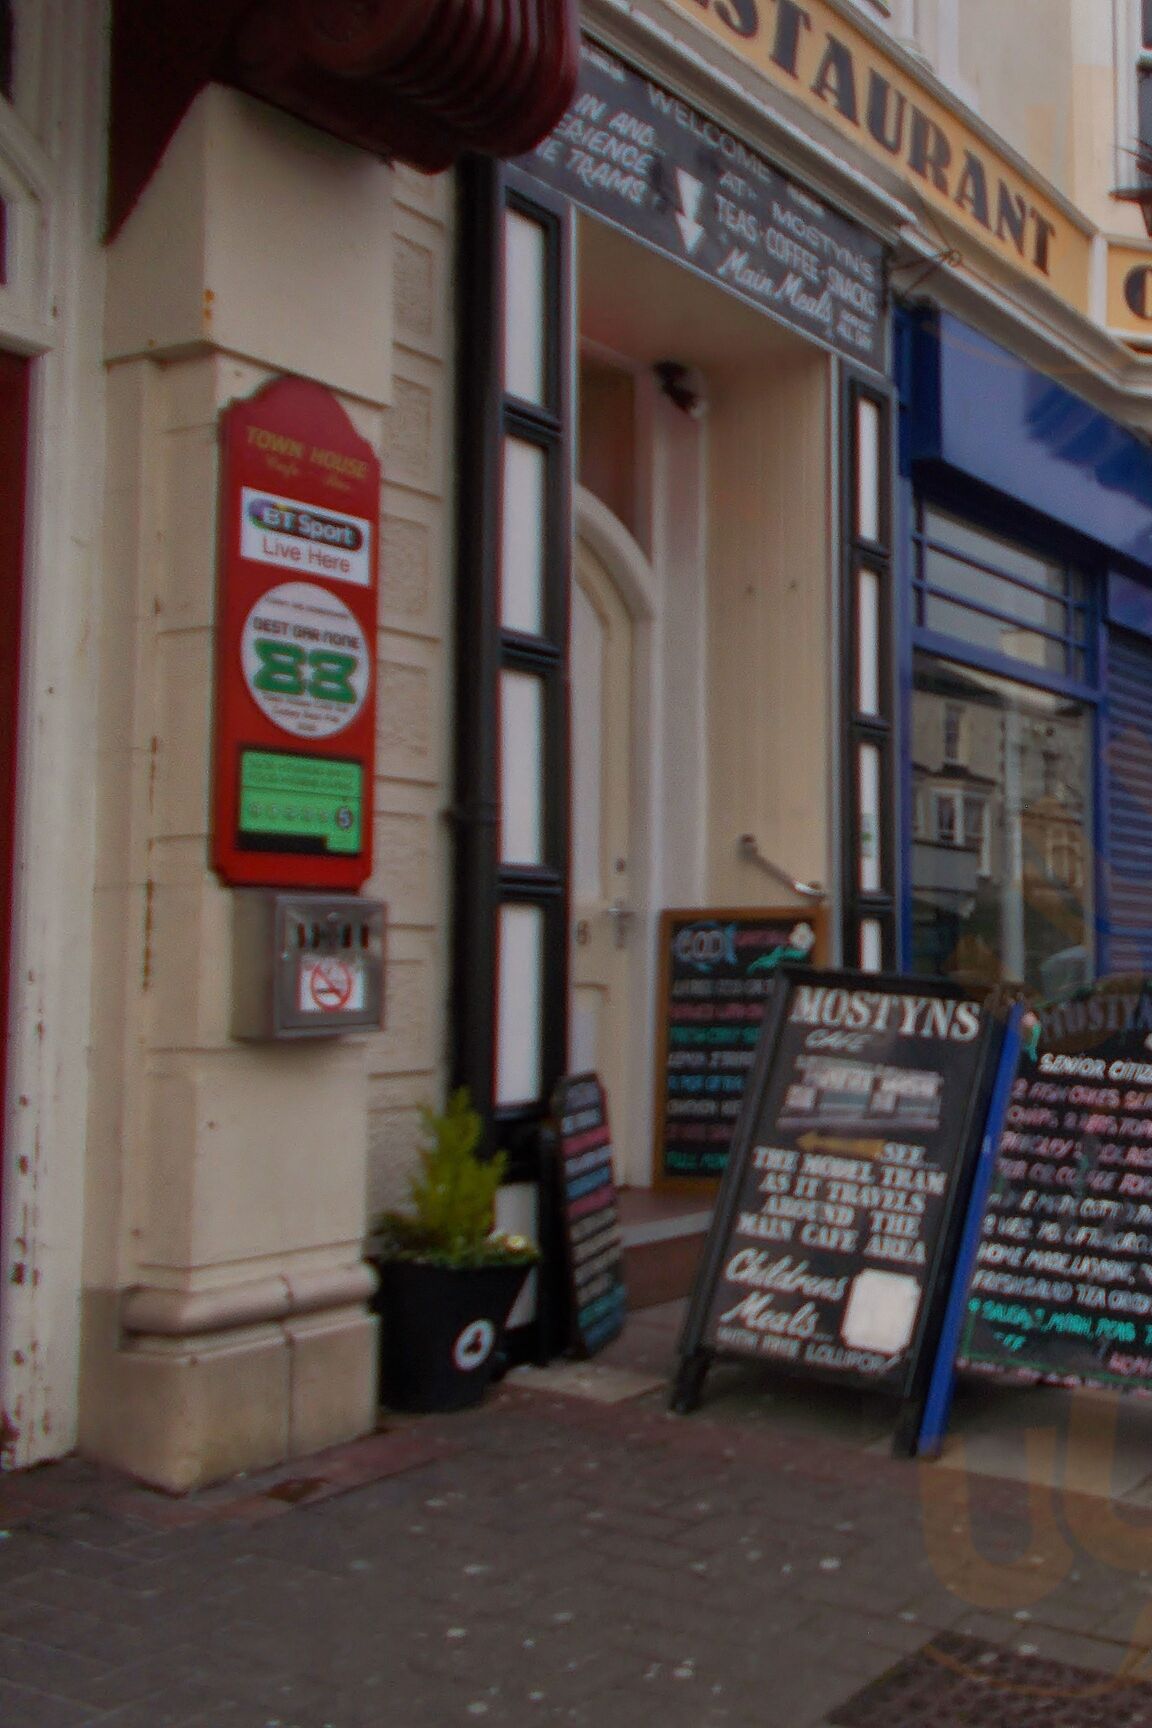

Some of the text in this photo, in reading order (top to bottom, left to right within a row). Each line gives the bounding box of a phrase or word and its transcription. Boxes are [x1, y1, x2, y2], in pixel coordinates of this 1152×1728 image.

[647, 83, 771, 184] WELCOME
[298, 513, 355, 545] Sport
[263, 537, 350, 573] Live Here
[788, 985, 983, 1042] MOSTYNS
[1039, 1053, 1107, 1080] SENIOR
[753, 1145, 800, 1172] THE
[880, 1165, 948, 1195] TRAM
[759, 1171, 927, 1215] AS IT TRAVELS
[870, 1209, 922, 1238] THE
[864, 1233, 927, 1264] AREA
